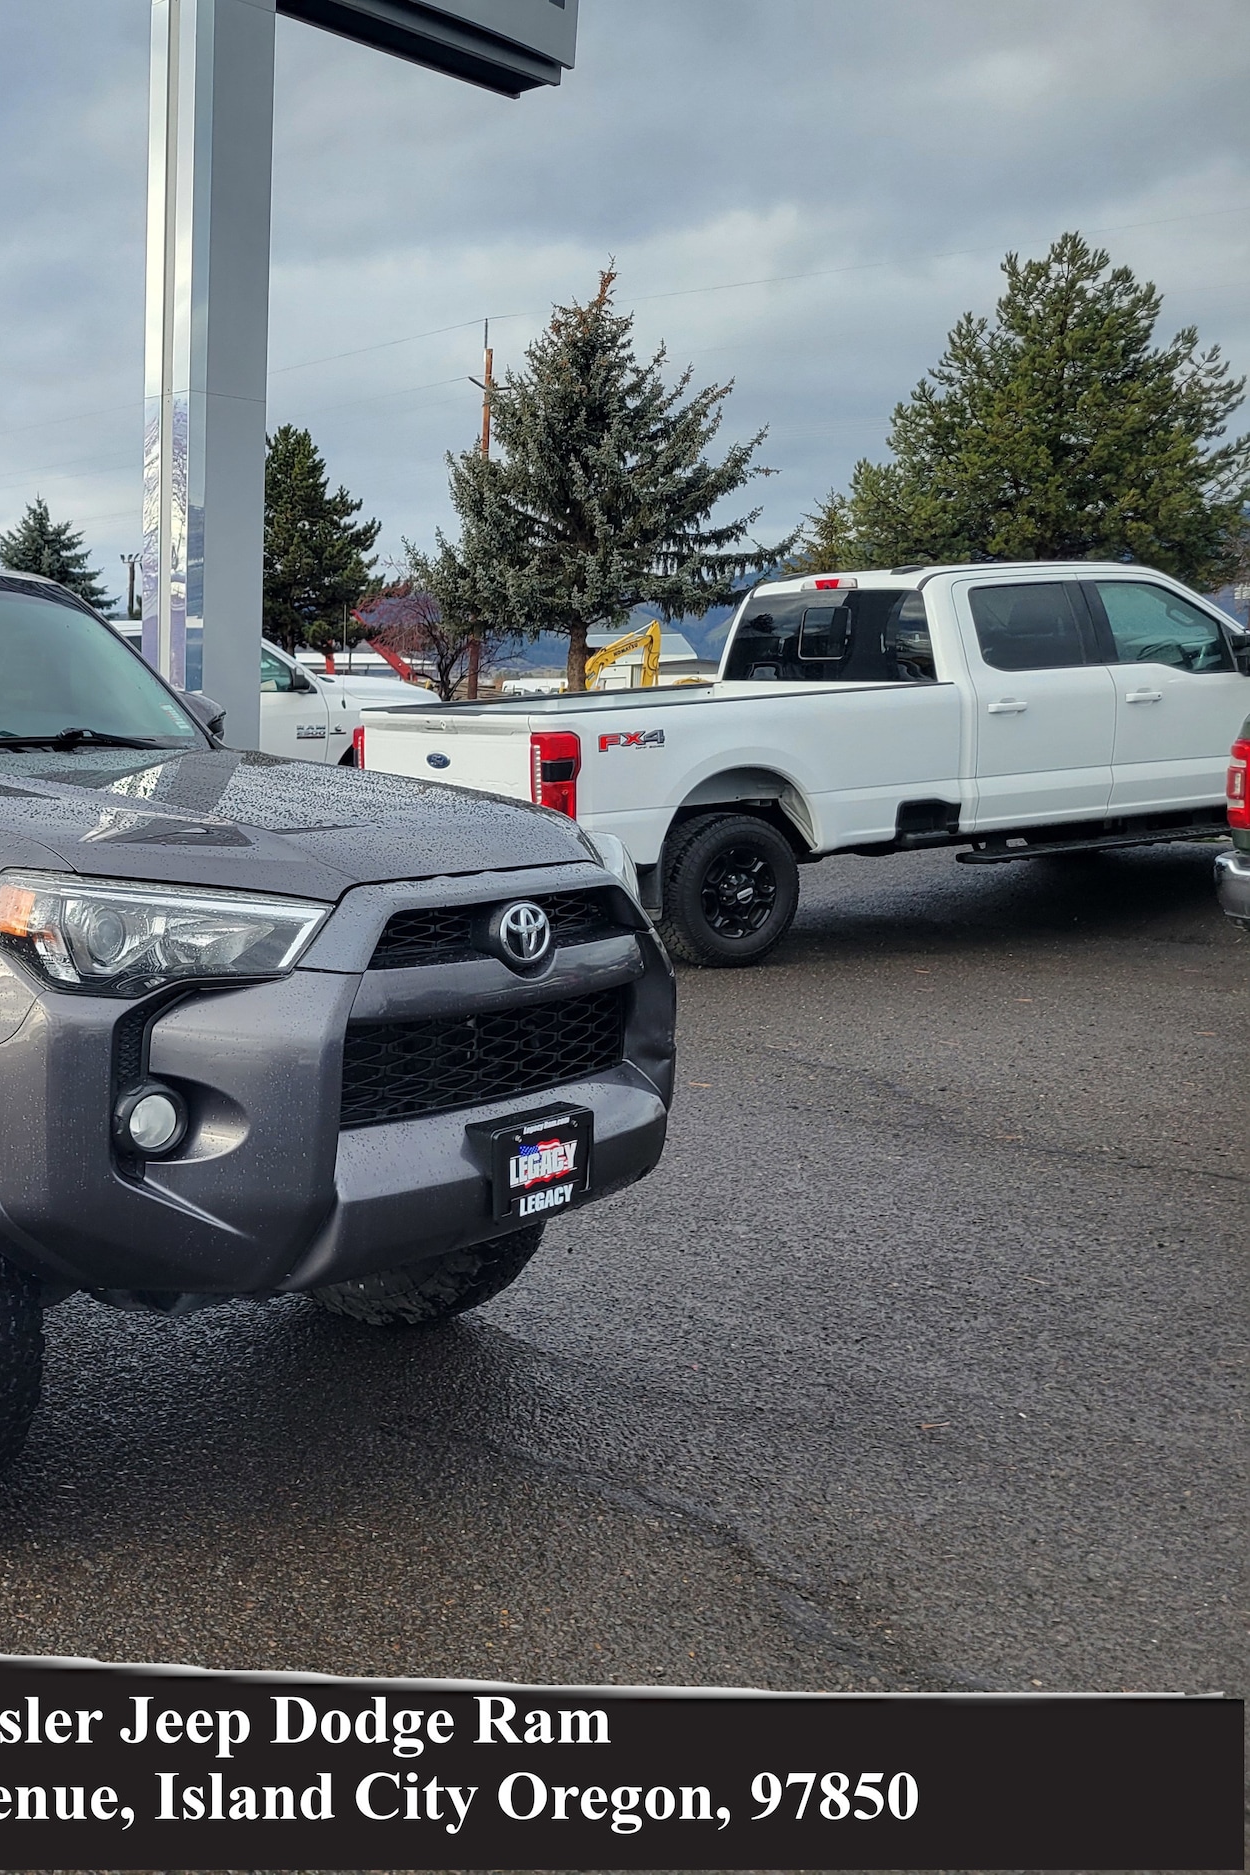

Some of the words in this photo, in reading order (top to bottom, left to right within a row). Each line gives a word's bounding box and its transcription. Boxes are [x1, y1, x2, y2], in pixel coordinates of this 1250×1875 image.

[598, 729, 665, 752] FX4
[510, 1142, 578, 1187] LEGACY
[519, 1184, 574, 1217] LEGACY
